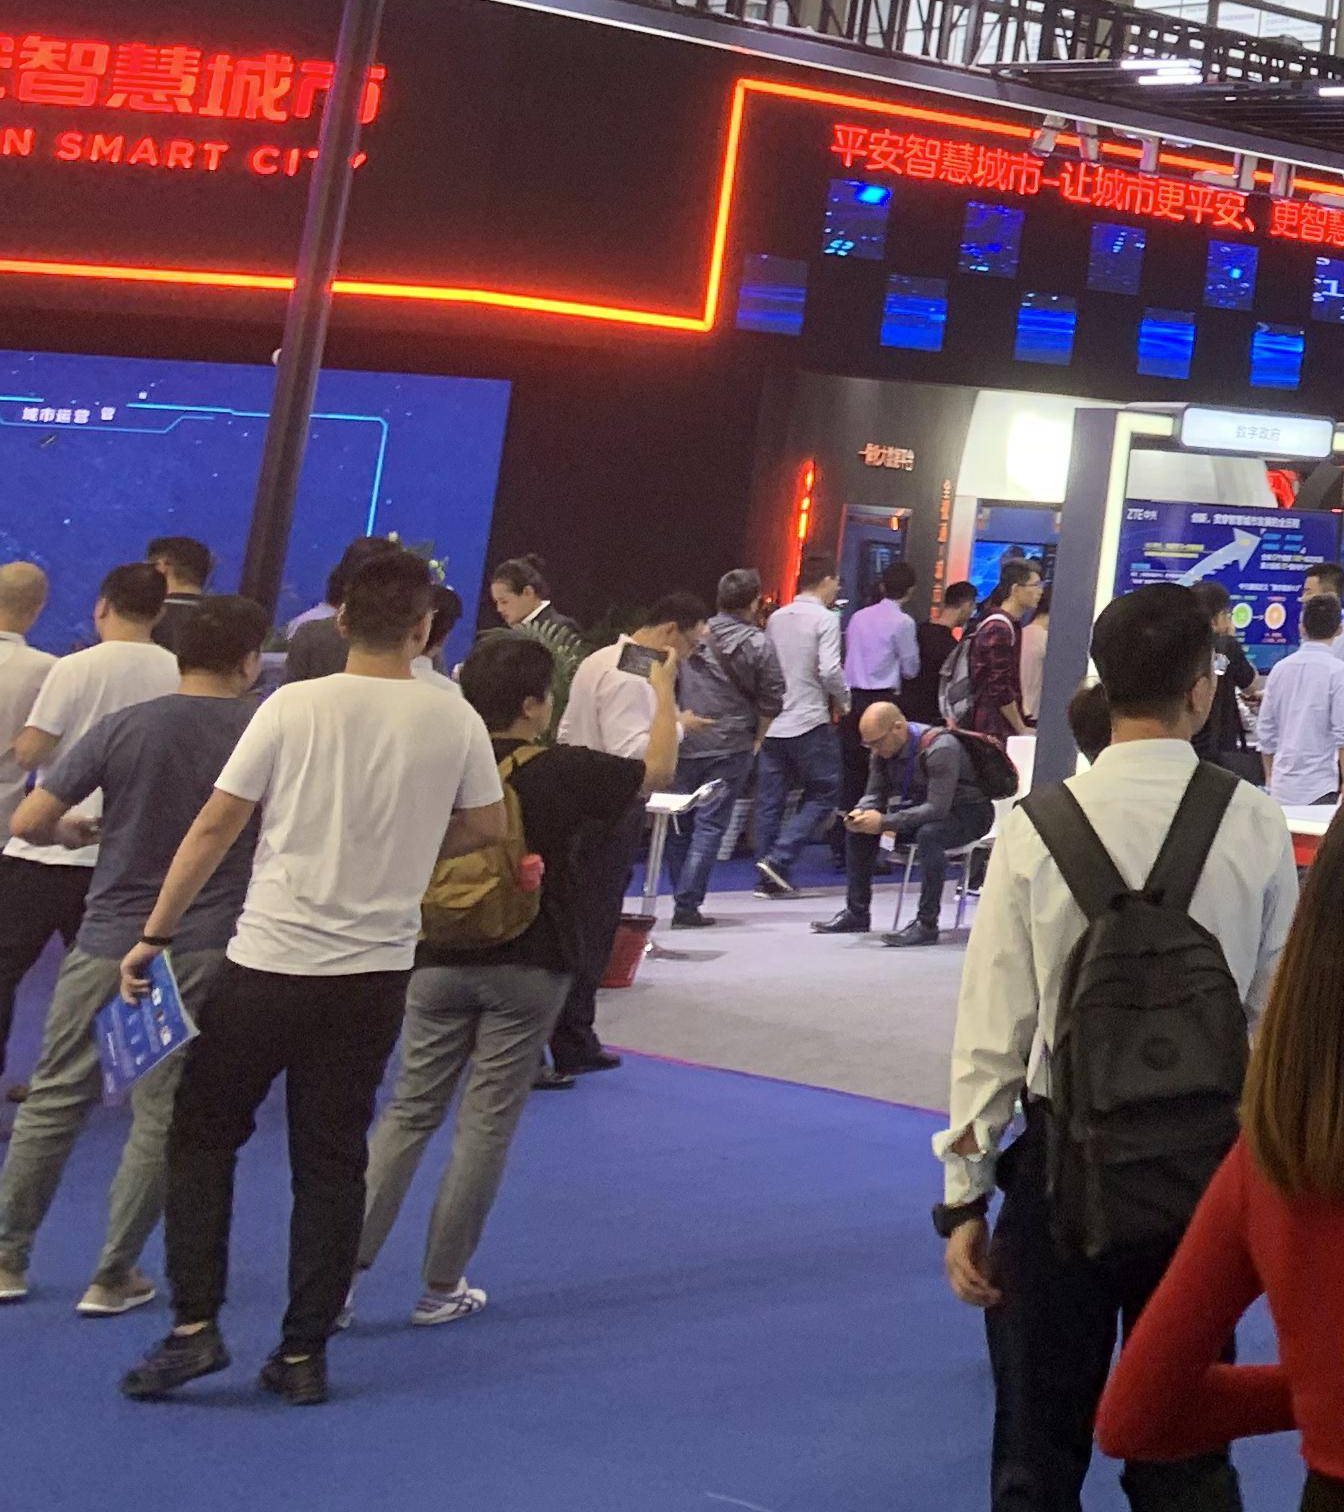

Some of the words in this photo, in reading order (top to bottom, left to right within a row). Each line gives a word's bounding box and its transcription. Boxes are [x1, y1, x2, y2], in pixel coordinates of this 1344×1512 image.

[0, 36, 388, 124] 智慧城市
[57, 131, 230, 172] SMART
[250, 144, 368, 178] CI
